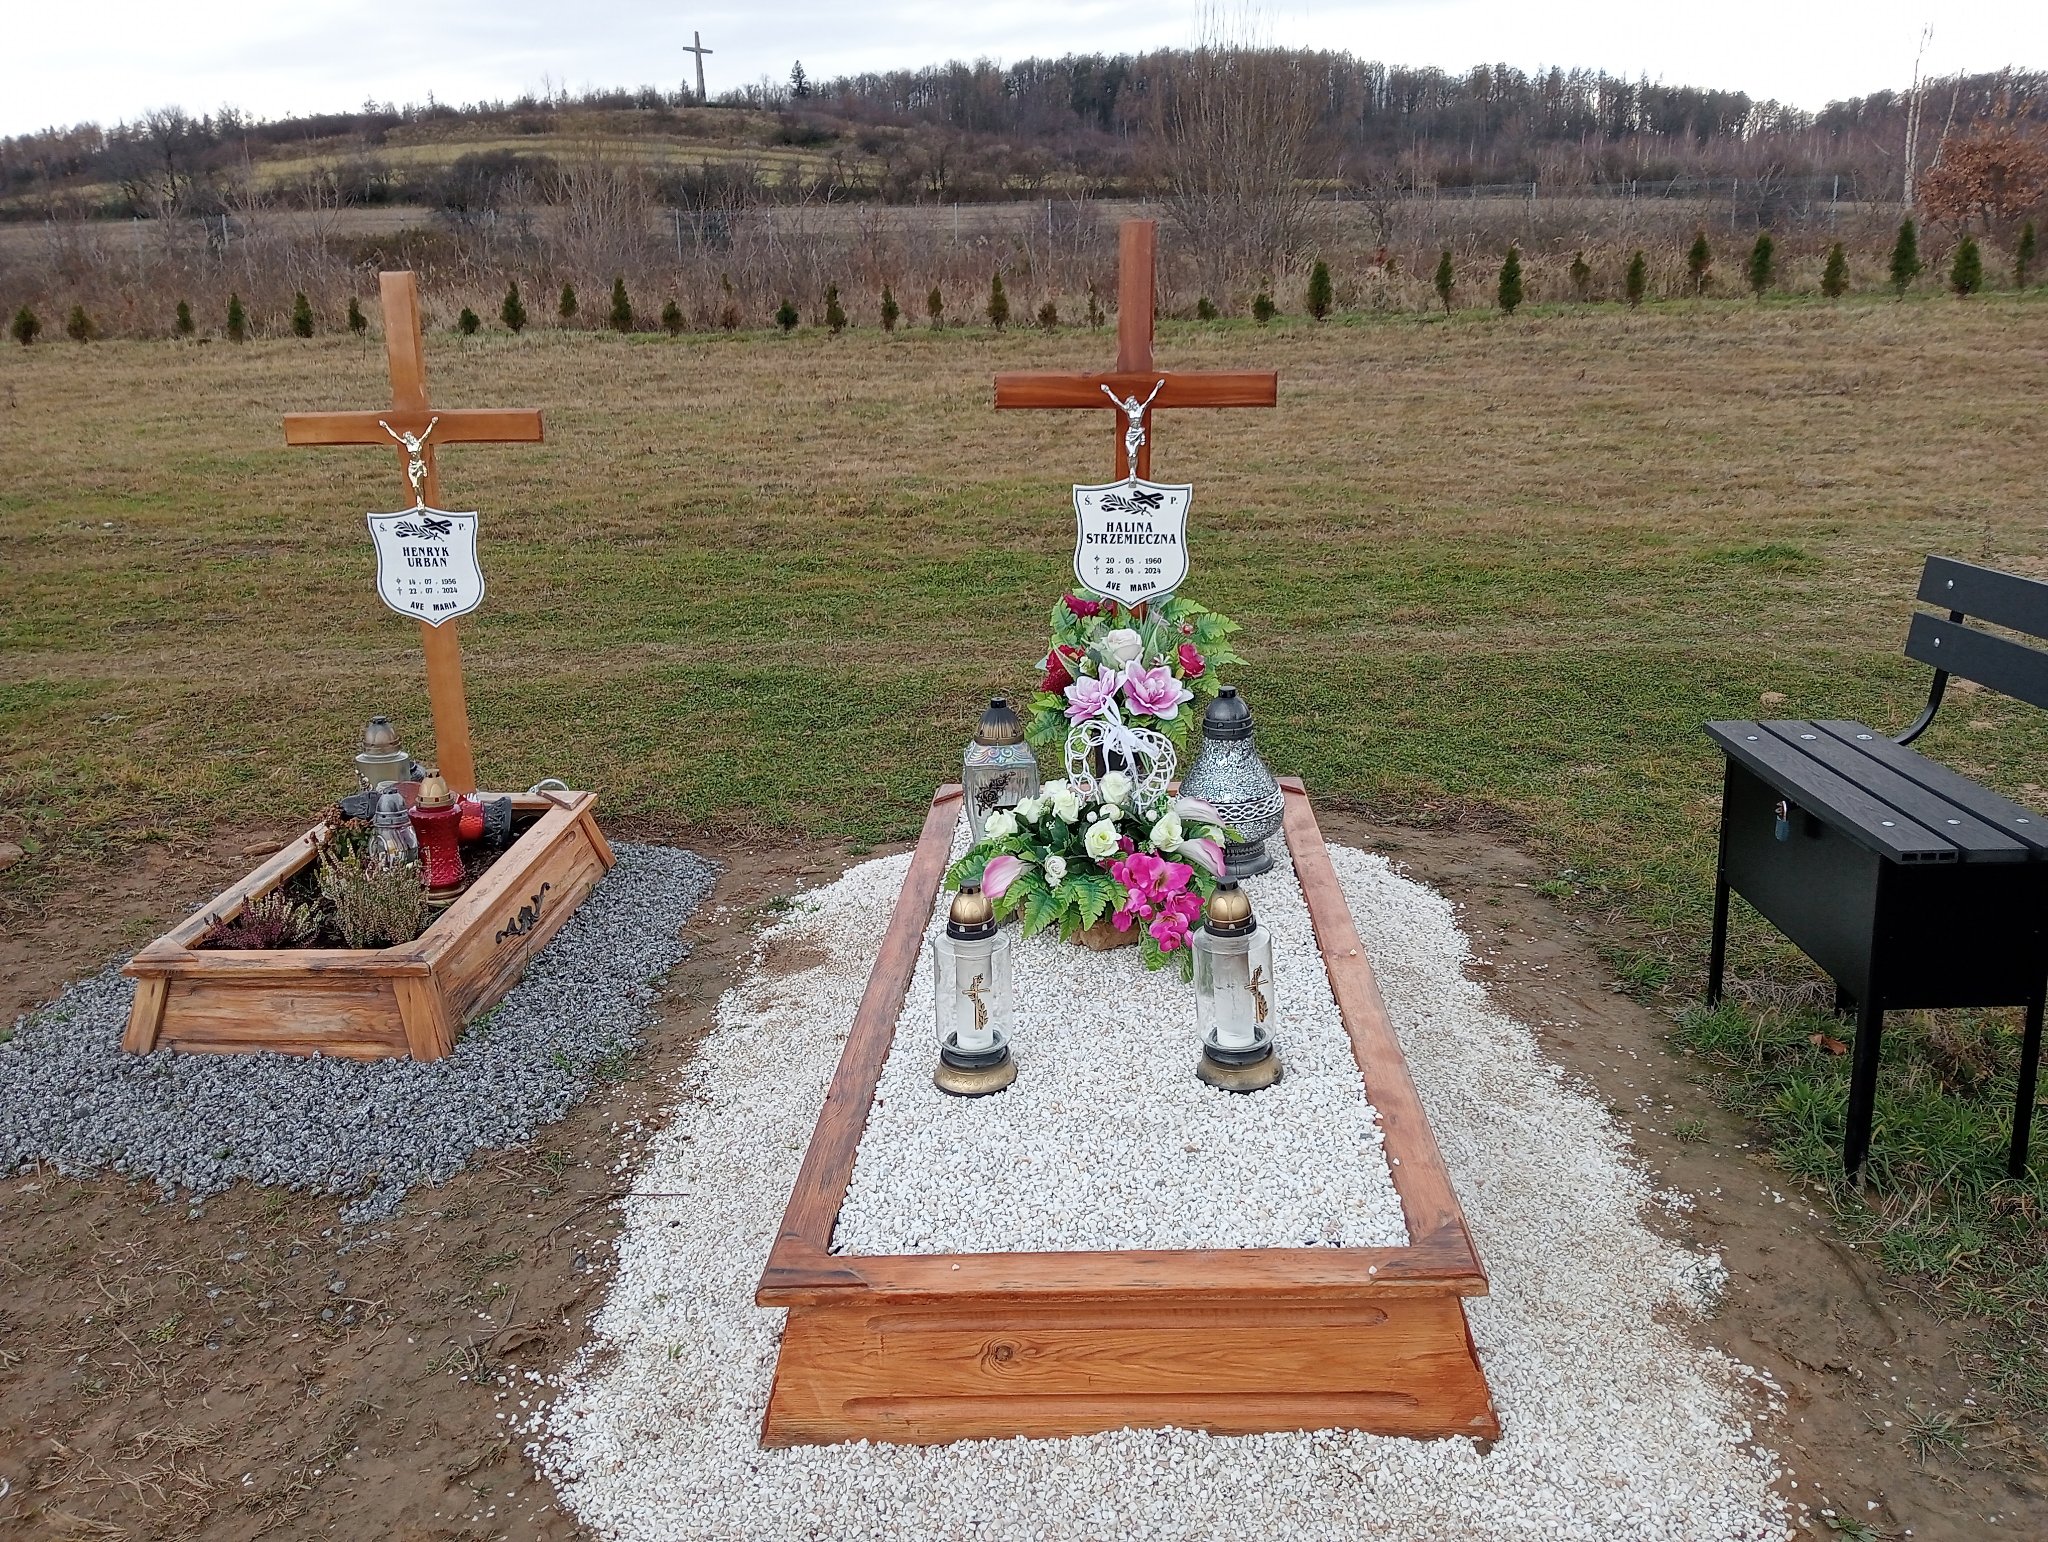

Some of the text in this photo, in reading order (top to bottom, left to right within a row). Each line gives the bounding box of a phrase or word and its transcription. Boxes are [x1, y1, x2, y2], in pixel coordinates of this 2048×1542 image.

[1106, 522, 1153, 533] HALINA
[1086, 533, 1177, 545] STRZEMIECZNA
[402, 546, 450, 557] HENRYK
[407, 557, 448, 568] URBAN
[1105, 580, 1157, 592] AVE MARIA
[410, 600, 457, 611] AVE MARIA
